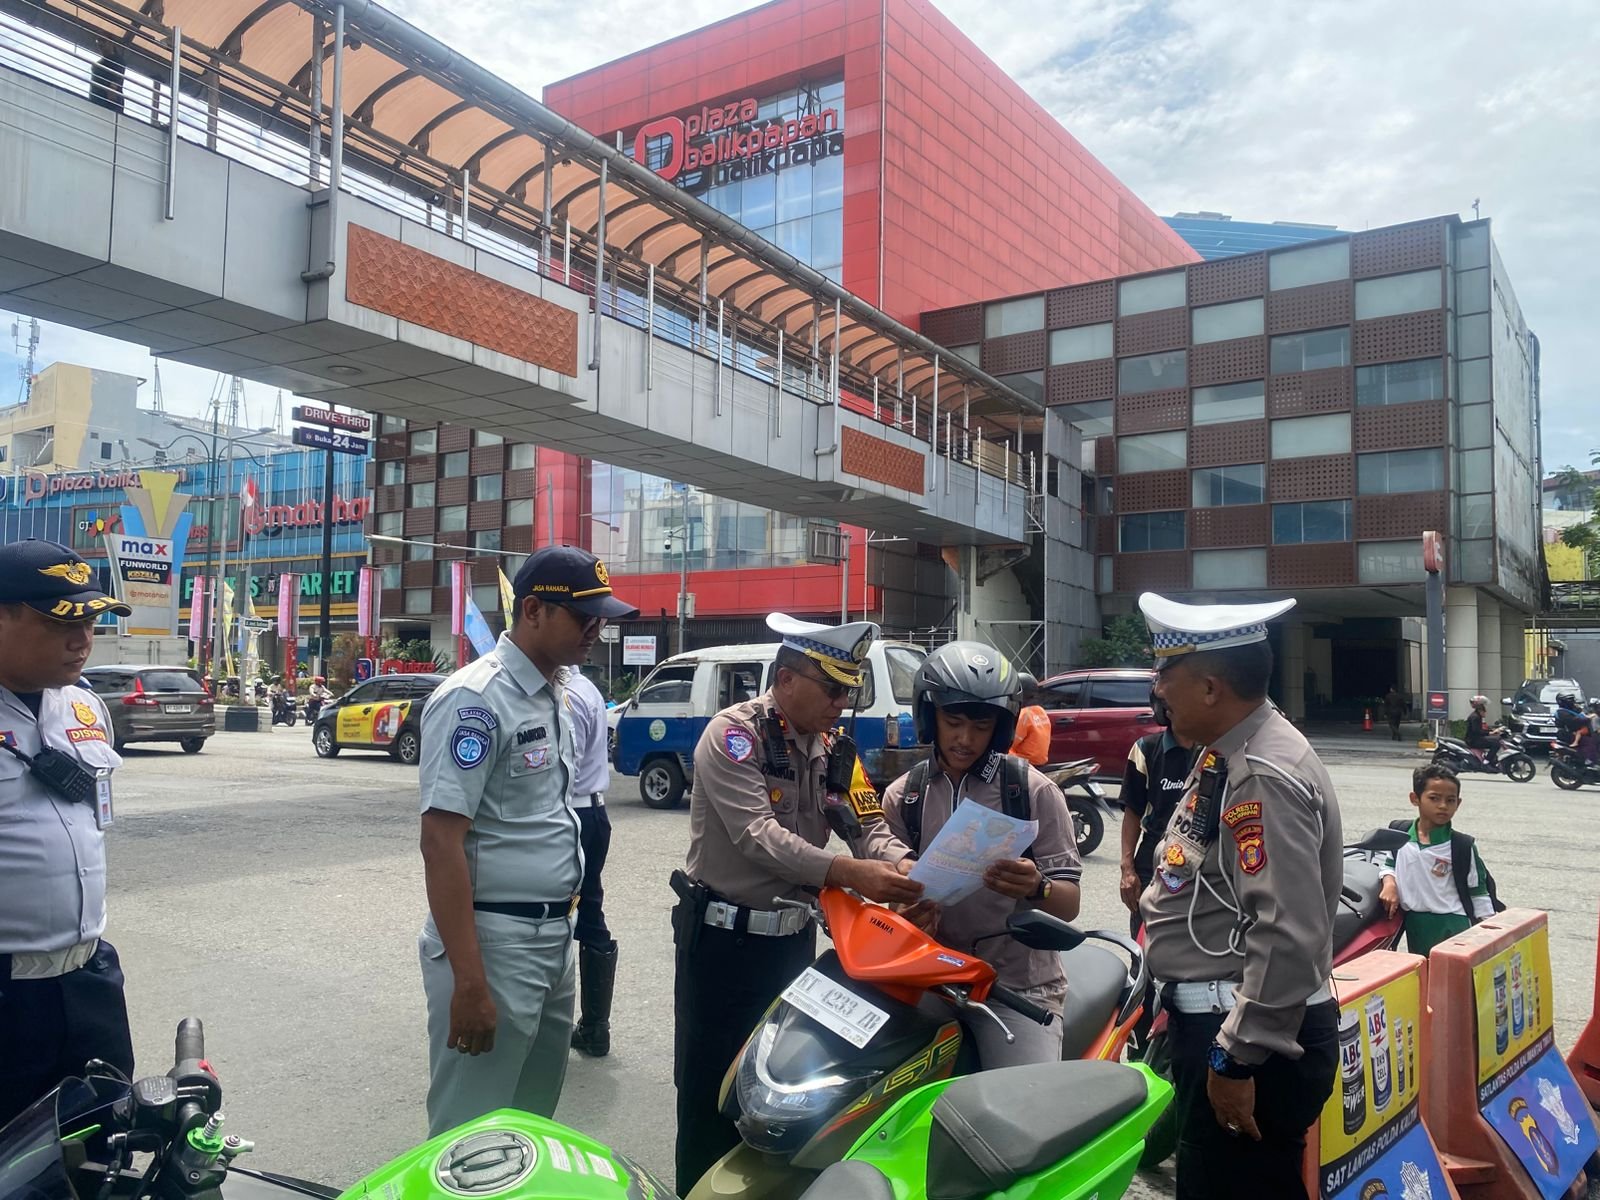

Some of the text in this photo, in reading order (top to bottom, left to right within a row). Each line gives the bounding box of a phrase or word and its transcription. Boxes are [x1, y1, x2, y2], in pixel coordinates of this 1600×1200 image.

[685, 98, 758, 142] plaza
[684, 108, 839, 170] balikpapan
[305, 407, 369, 428] DRIVE-THRU
[314, 434, 365, 450] Buka 24 Jam
[121, 540, 168, 556] max
[120, 560, 168, 571] FUNWORLD
[532, 584, 544, 592] JASA
[1225, 803, 1259, 819] POLRESTA
[869, 916, 894, 934] YAMAHA
[820, 988, 859, 1018] 4233
[1368, 1008, 1386, 1037] ABC
[1342, 1039, 1361, 1067] ABC
[1326, 1165, 1346, 1193] SAT
[1346, 1141, 1377, 1179] LANTAS
[1375, 1122, 1399, 1154] POLDA
